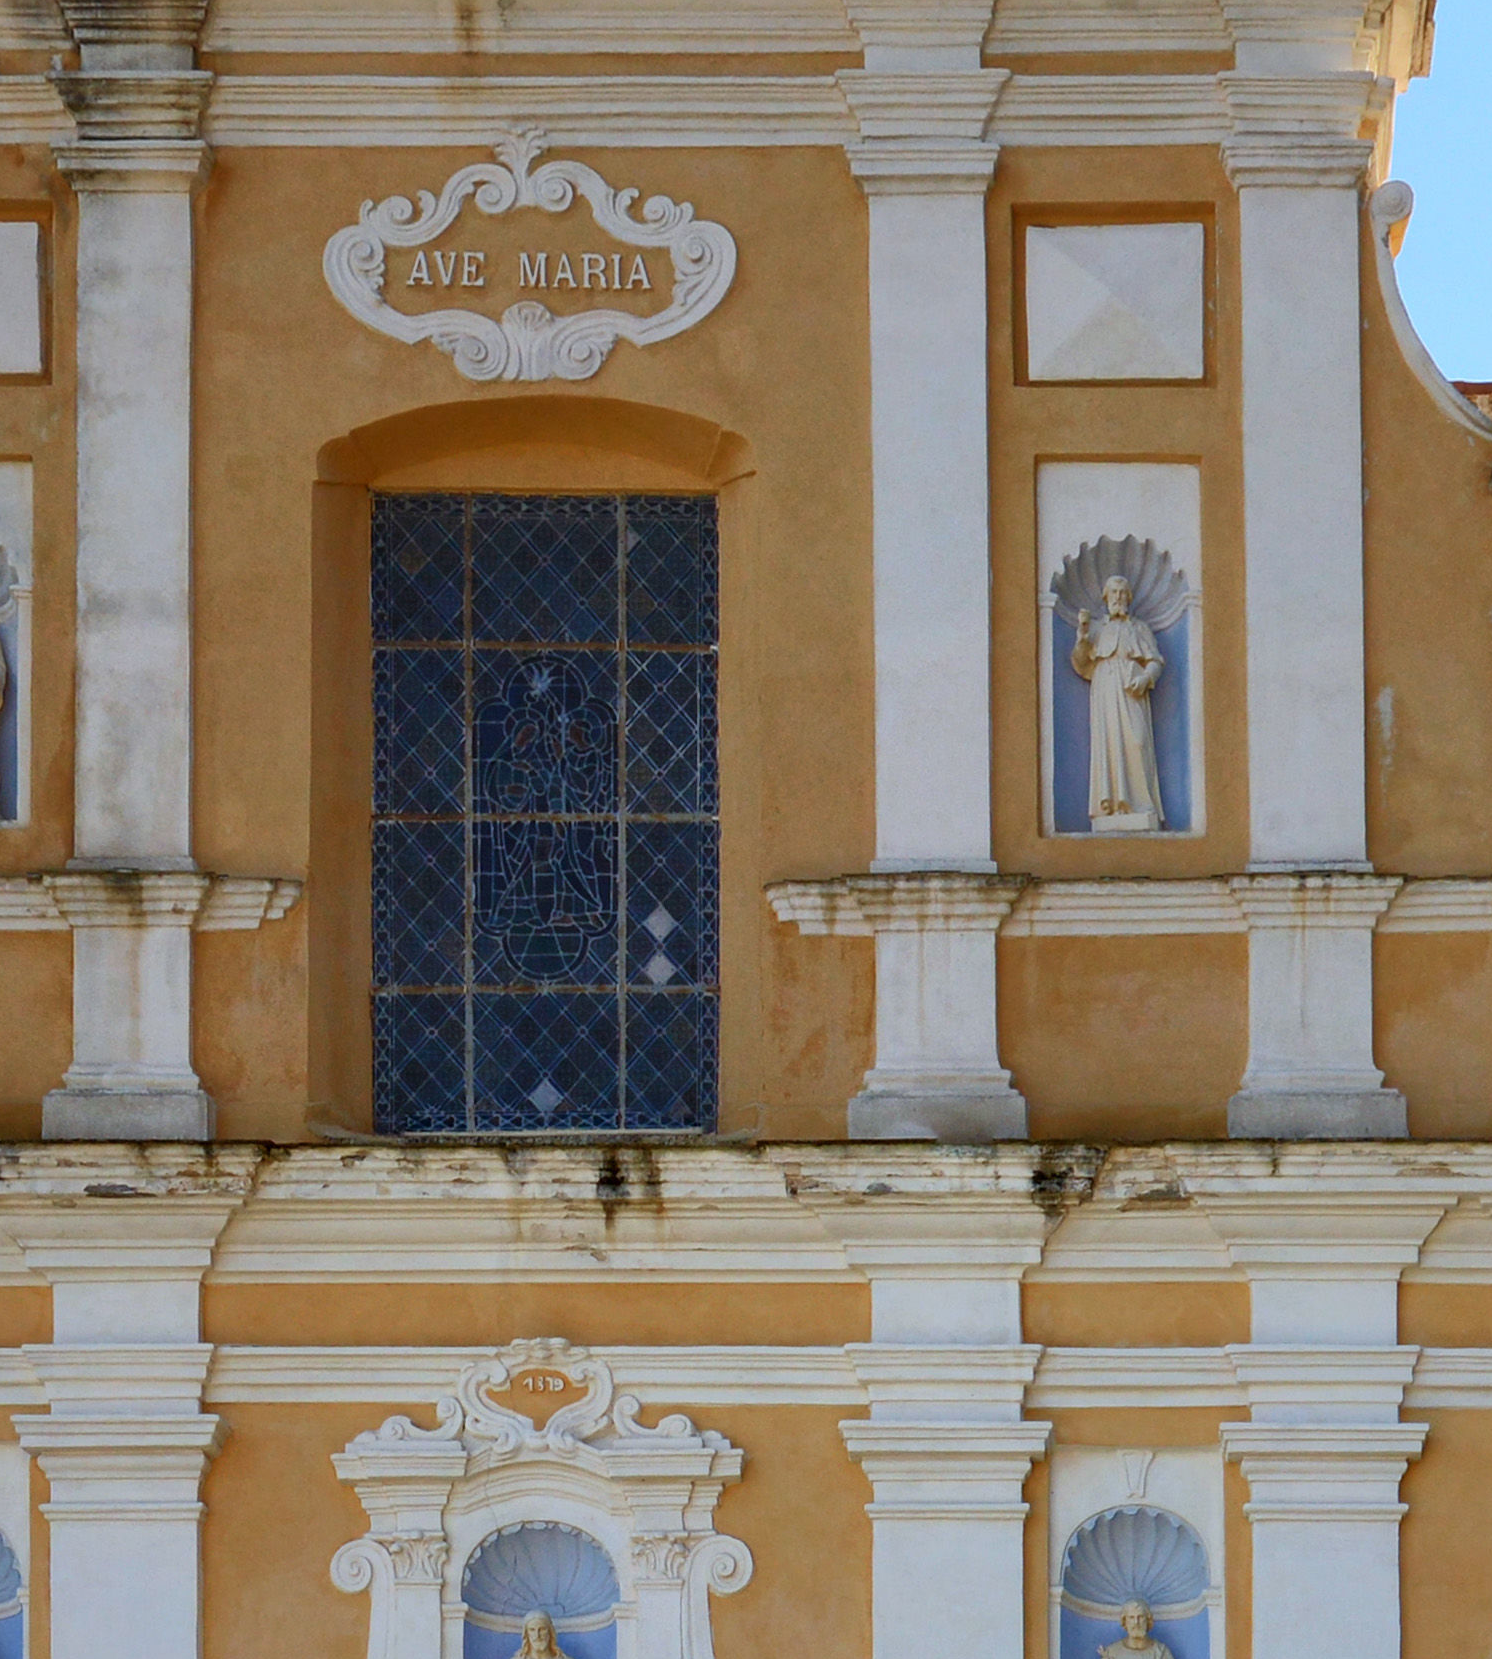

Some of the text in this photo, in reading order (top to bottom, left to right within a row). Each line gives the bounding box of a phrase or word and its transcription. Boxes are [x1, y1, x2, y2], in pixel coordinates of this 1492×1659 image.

[406, 250, 652, 289] AVE MARIA
[522, 1376, 566, 1393] 1879
